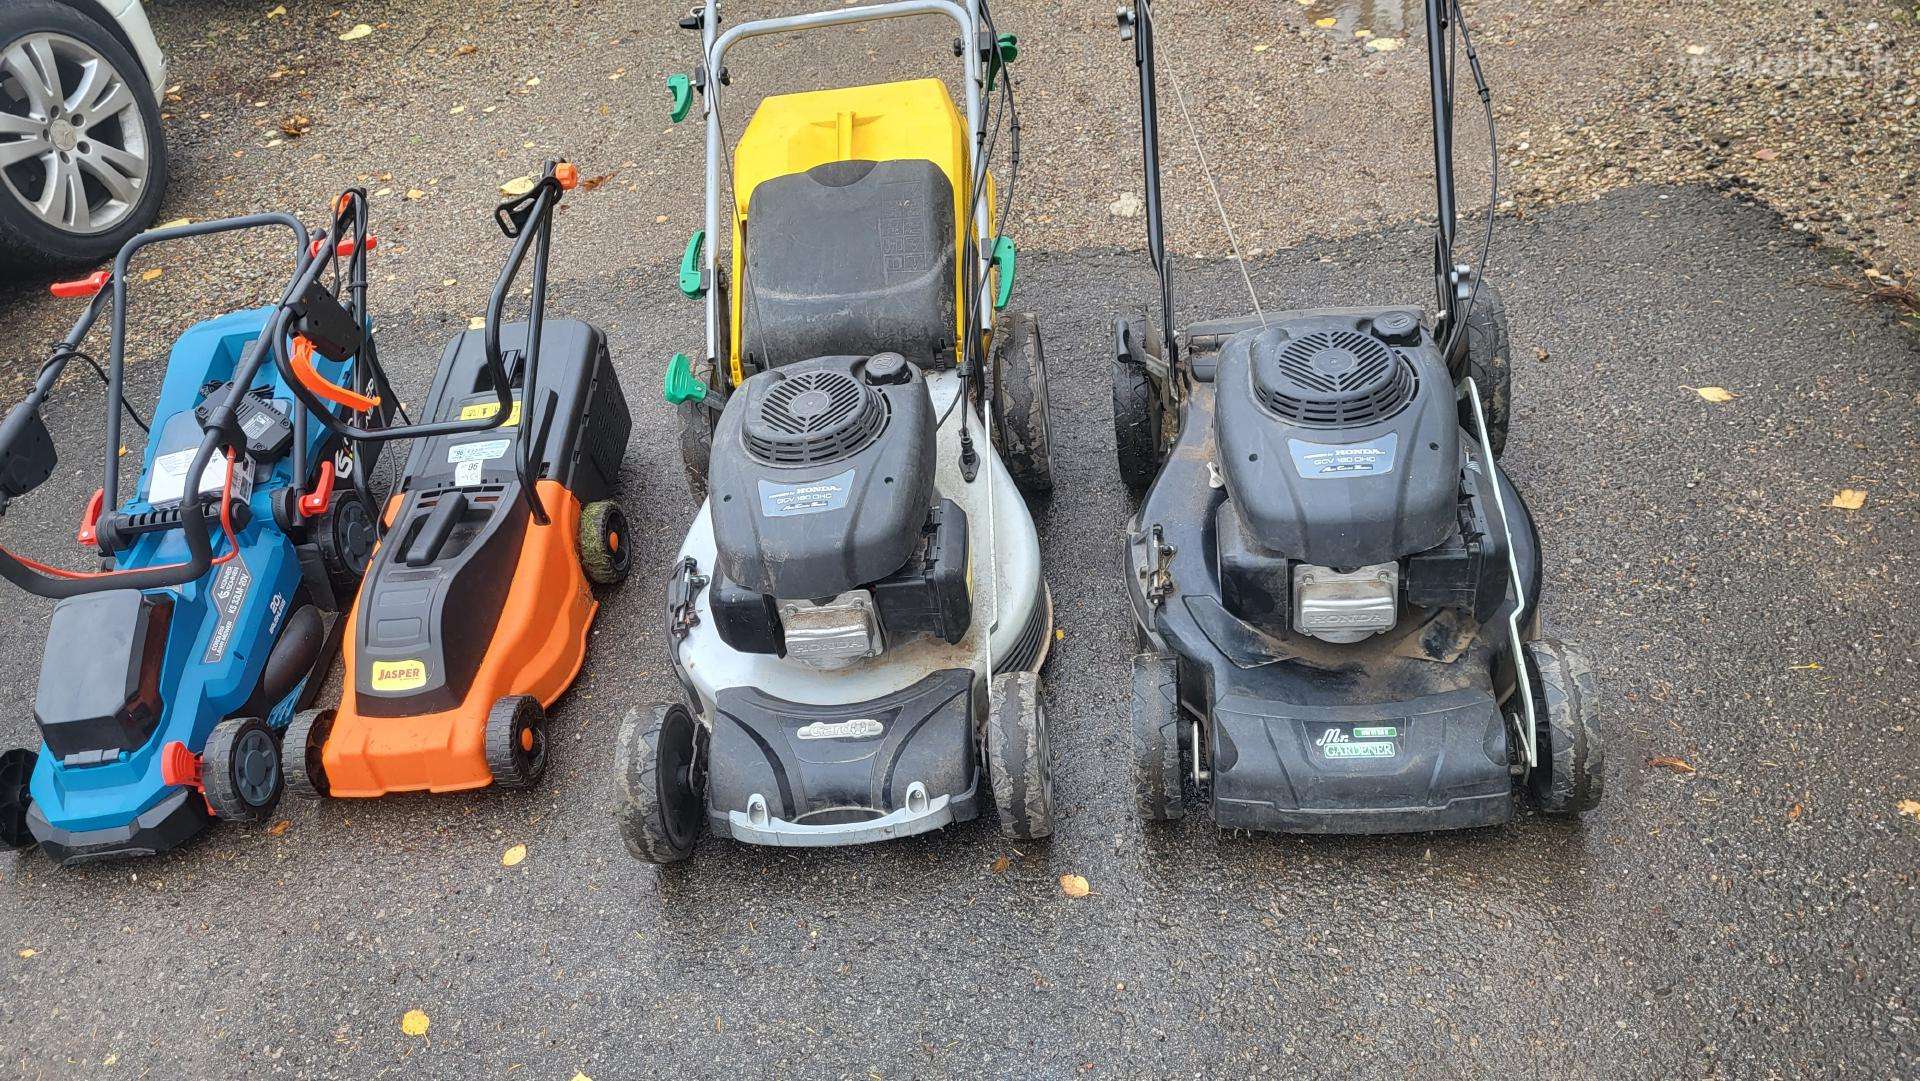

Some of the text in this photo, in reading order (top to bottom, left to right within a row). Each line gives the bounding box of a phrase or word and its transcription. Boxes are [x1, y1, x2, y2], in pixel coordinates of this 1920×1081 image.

[1335, 448, 1381, 456] HONDA
[1314, 457, 1334, 466] GCV
[796, 485, 839, 494] HONDA
[378, 668, 420, 681] JASPER
[1316, 728, 1349, 746] Mr.
[1326, 744, 1393, 757] GARDENER
